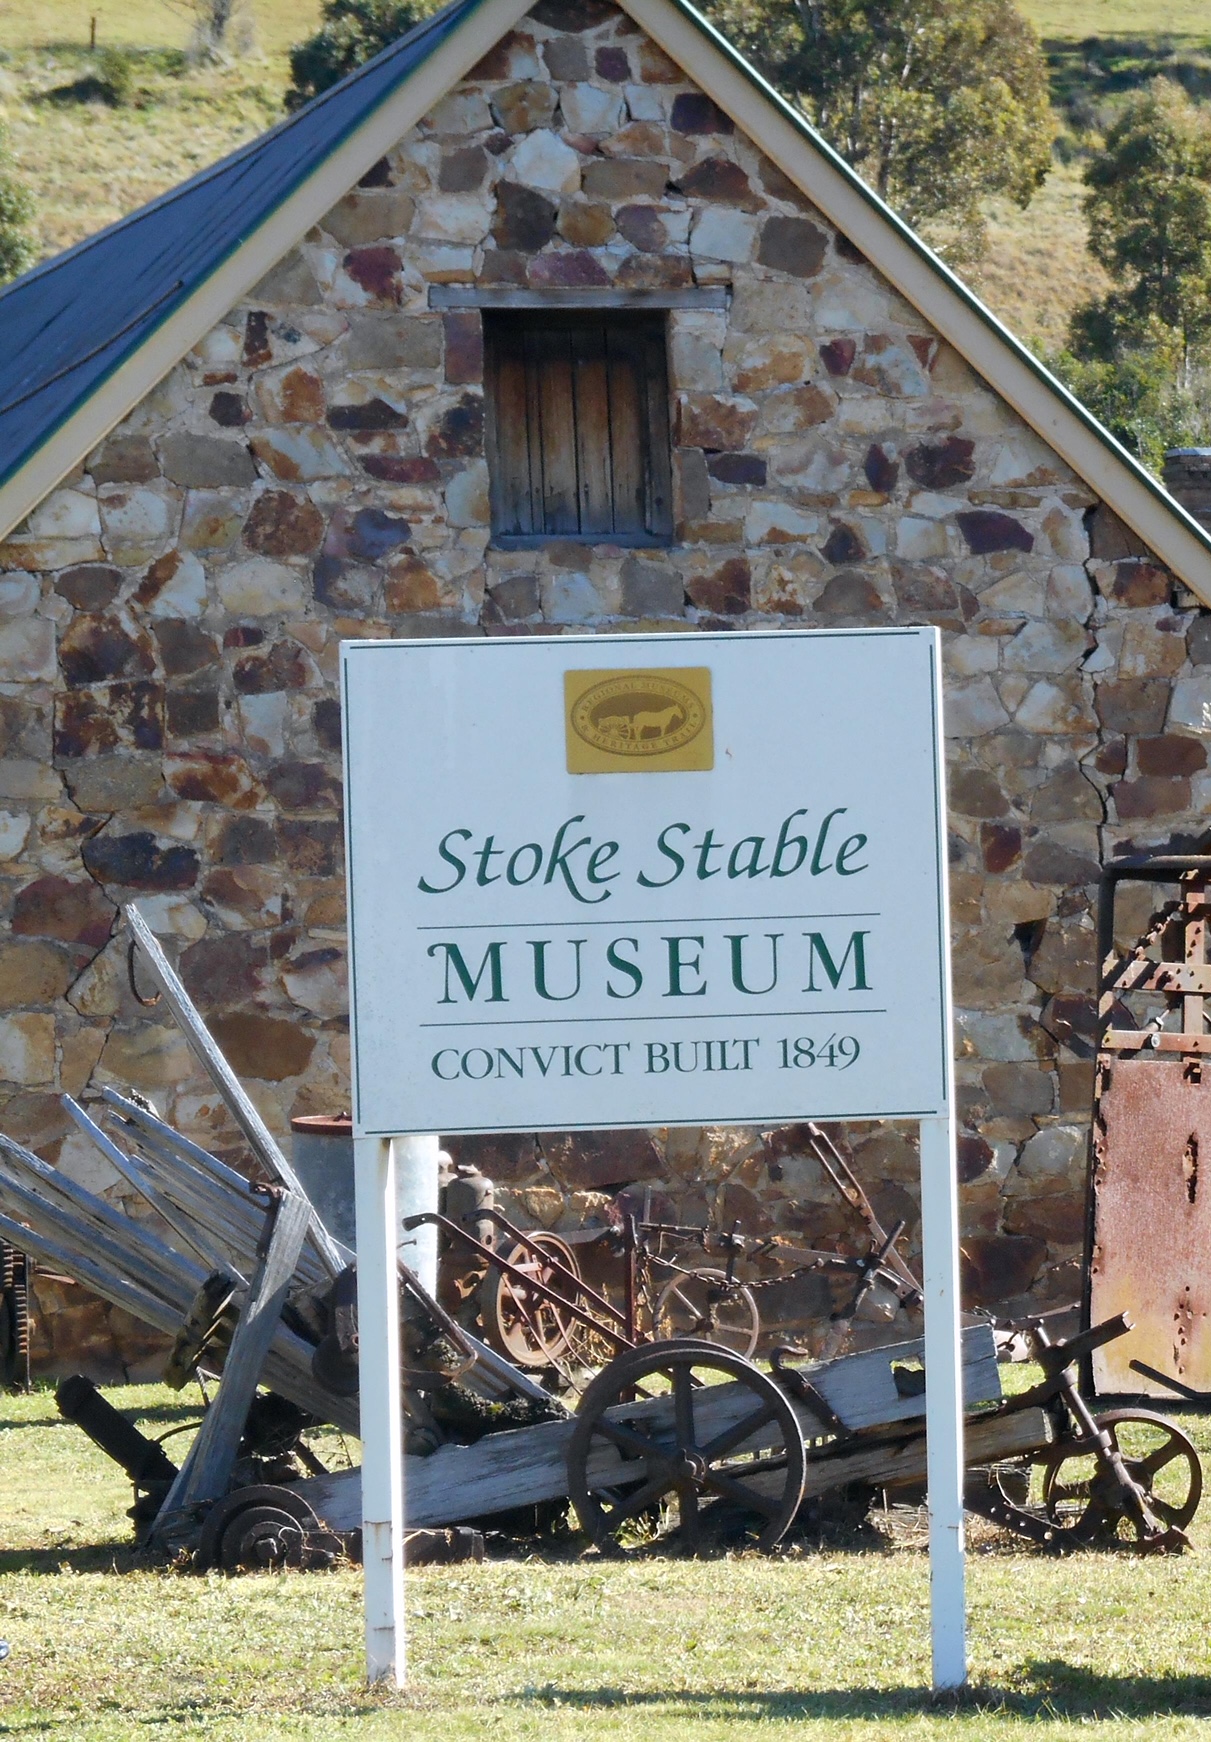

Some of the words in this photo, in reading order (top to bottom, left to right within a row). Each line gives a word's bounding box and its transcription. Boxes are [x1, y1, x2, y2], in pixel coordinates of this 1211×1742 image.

[582, 681, 636, 713] REGIONAL
[640, 681, 696, 710] MUSEUMS
[592, 733, 657, 751] HERITAGE
[664, 722, 697, 747] TRAIL
[417, 815, 621, 905] Stoke
[636, 807, 869, 889] Stable
[426, 930, 874, 1005] MUSEUM
[430, 1041, 631, 1081] CONVICT
[643, 1037, 760, 1074] BUILT
[777, 1032, 861, 1074] 1849
